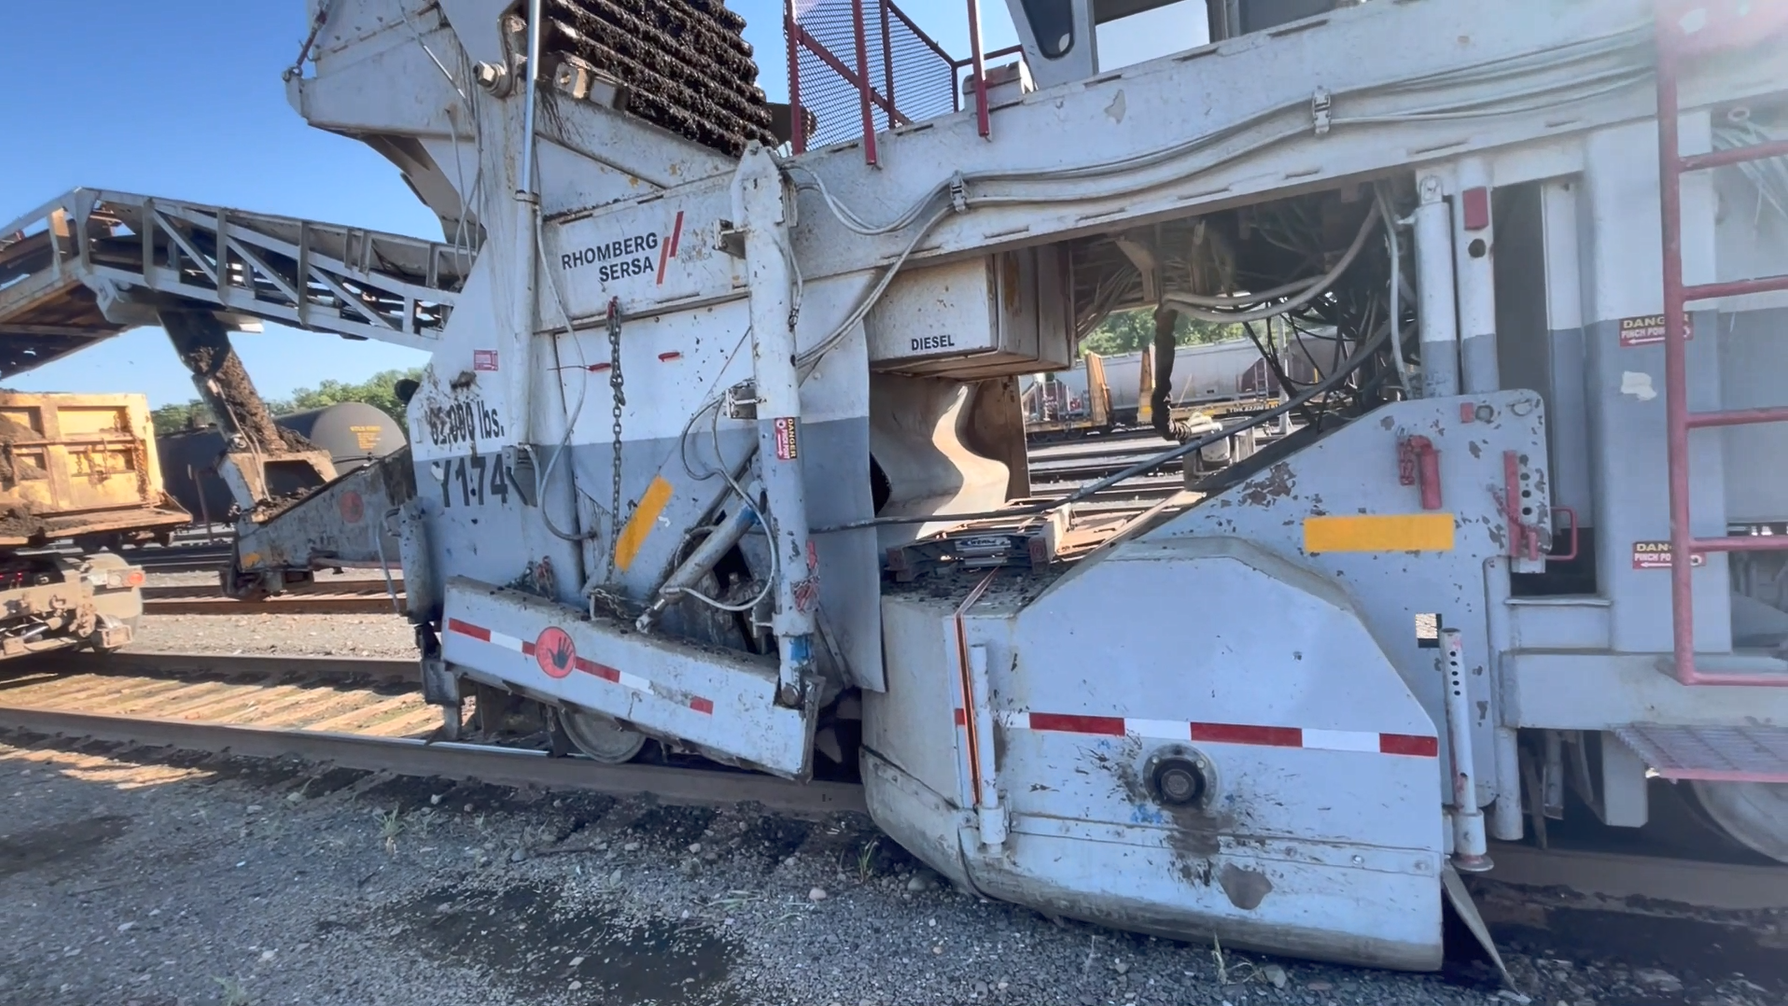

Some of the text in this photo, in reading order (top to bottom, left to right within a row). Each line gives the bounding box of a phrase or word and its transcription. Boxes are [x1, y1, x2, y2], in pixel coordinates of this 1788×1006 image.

[561, 232, 658, 270] RHOMBERG
[599, 256, 654, 282] SERSA
[911, 334, 955, 351] DIESEL
[1621, 327, 1666, 339] PINCH POIN
[476, 400, 505, 440] lbs.
[788, 418, 796, 457] DANGER
[432, 454, 508, 507] Y174
[1634, 553, 1659, 562] PINCH
[1636, 543, 1672, 552] DAN
